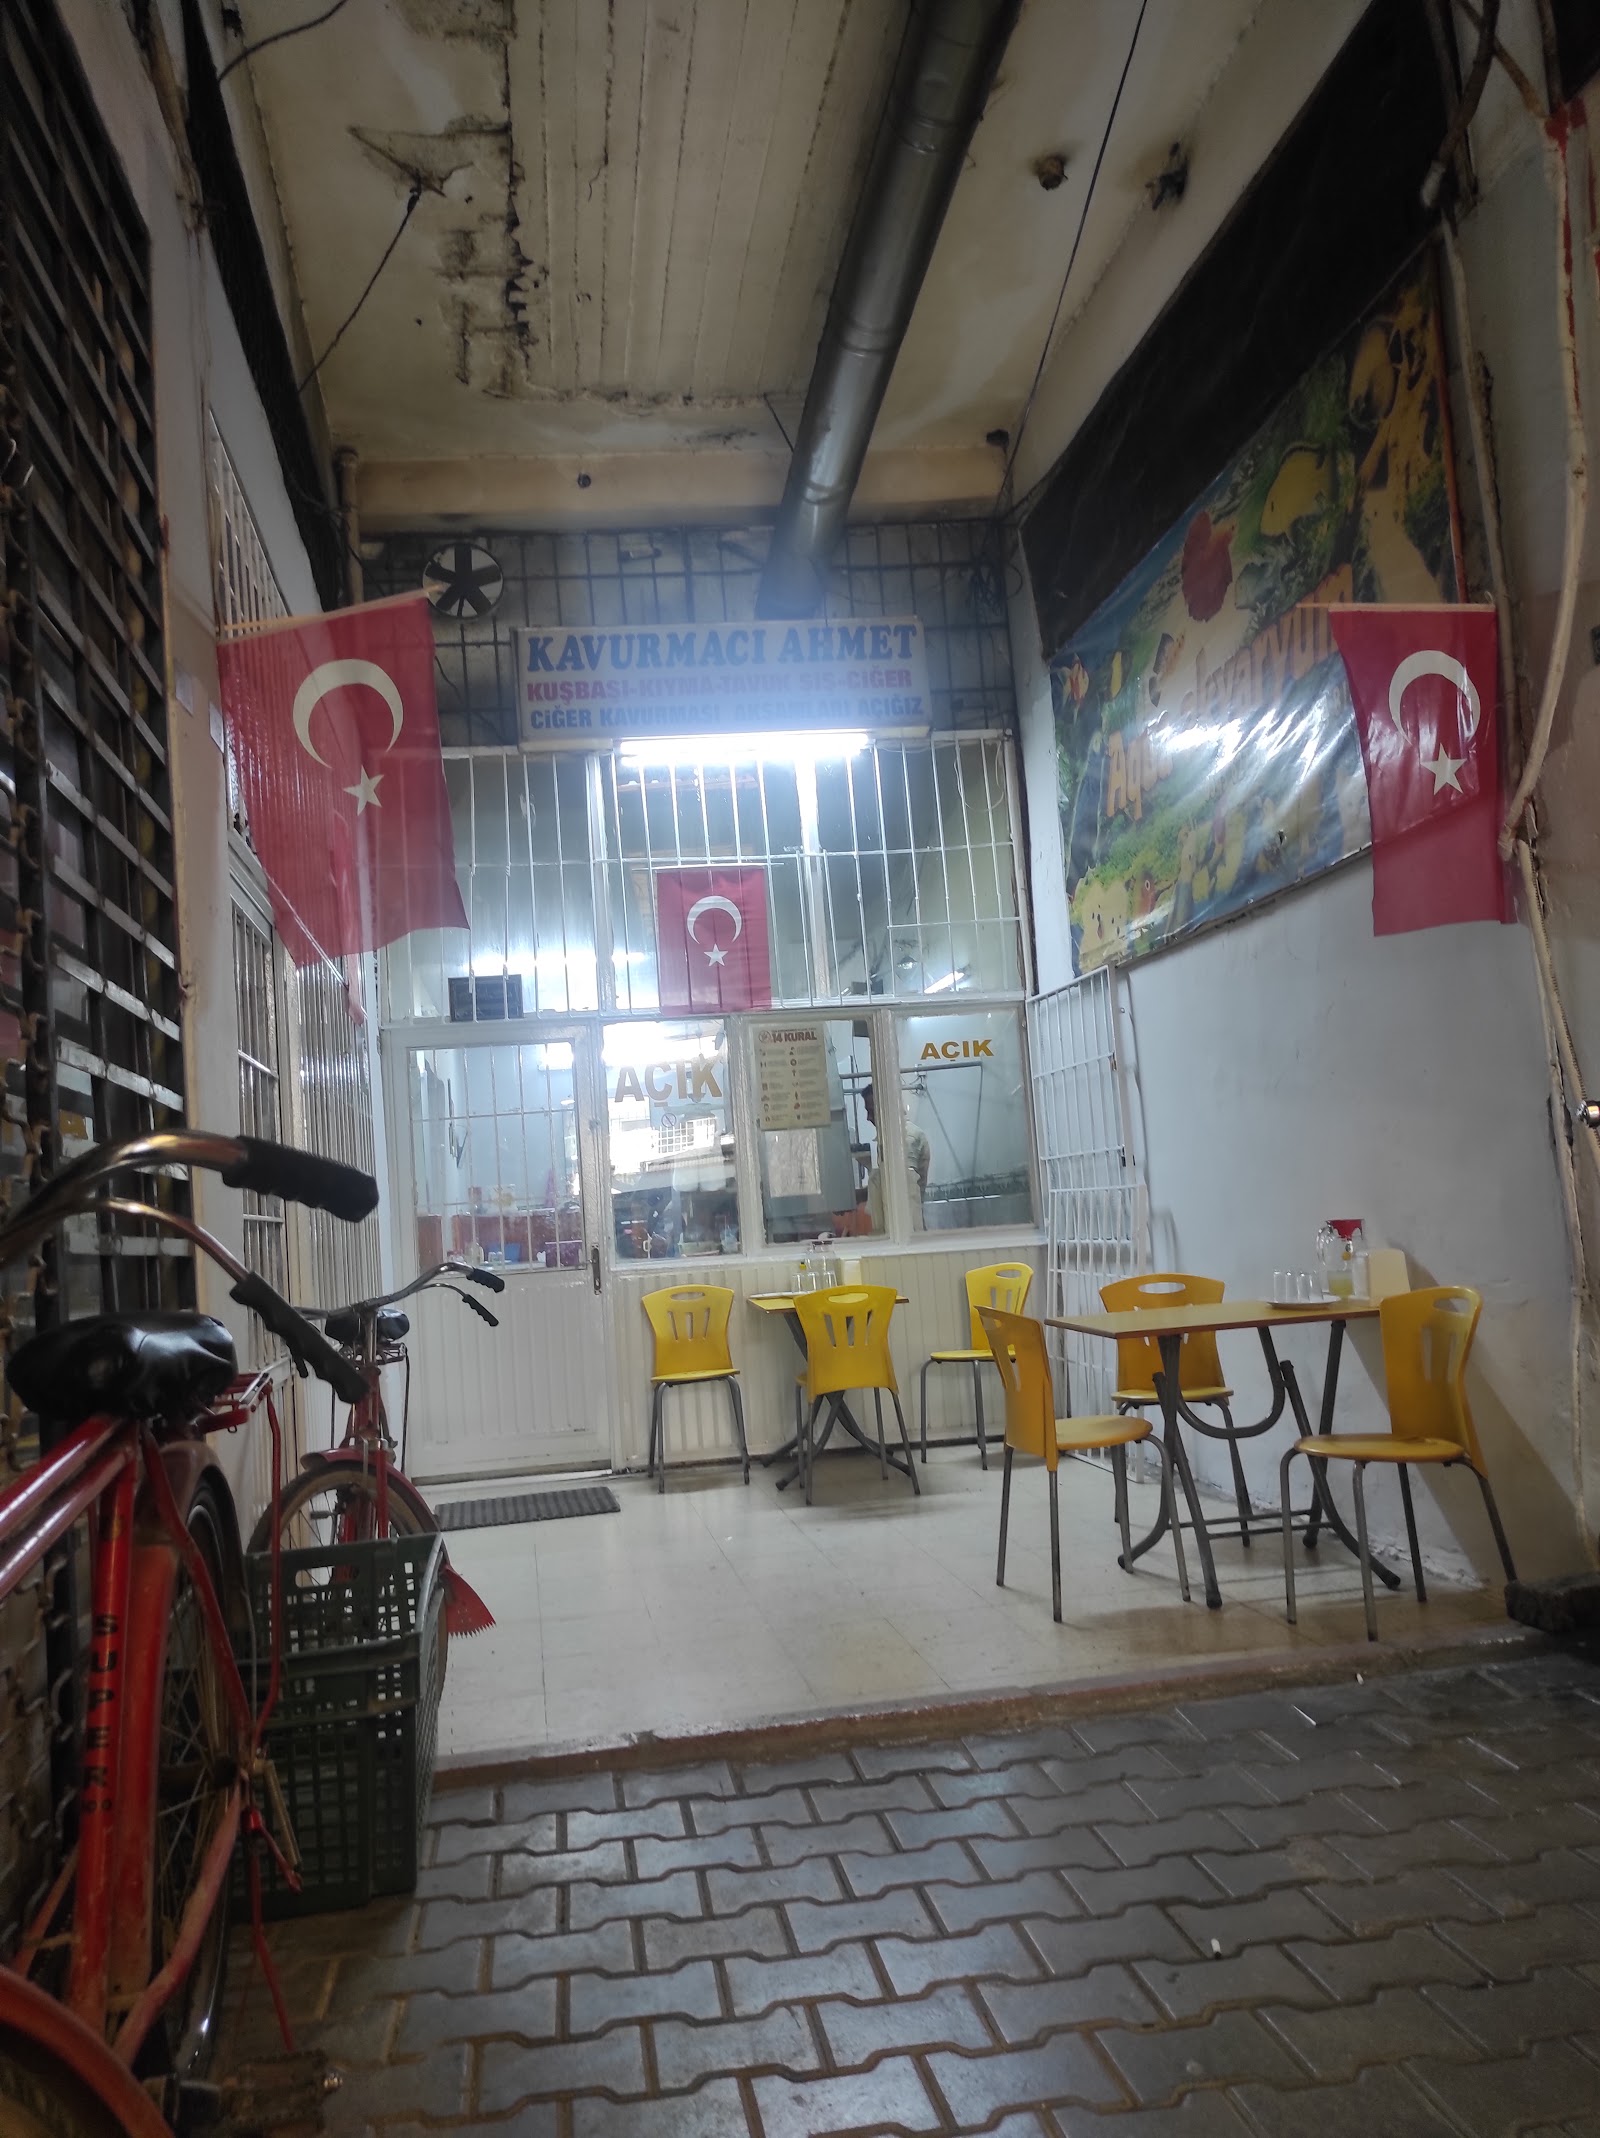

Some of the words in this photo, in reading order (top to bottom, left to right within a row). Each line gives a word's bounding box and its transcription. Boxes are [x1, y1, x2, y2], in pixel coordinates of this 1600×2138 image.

[526, 629, 767, 671] KAVURMACI
[777, 624, 918, 663] AHMET
[771, 1032, 783, 1043] 14
[784, 1031, 817, 1042] KURAL
[920, 1039, 994, 1061] AÇIK
[614, 1054, 724, 1106] AÇIK
[83, 1612, 118, 1788] SUPER
